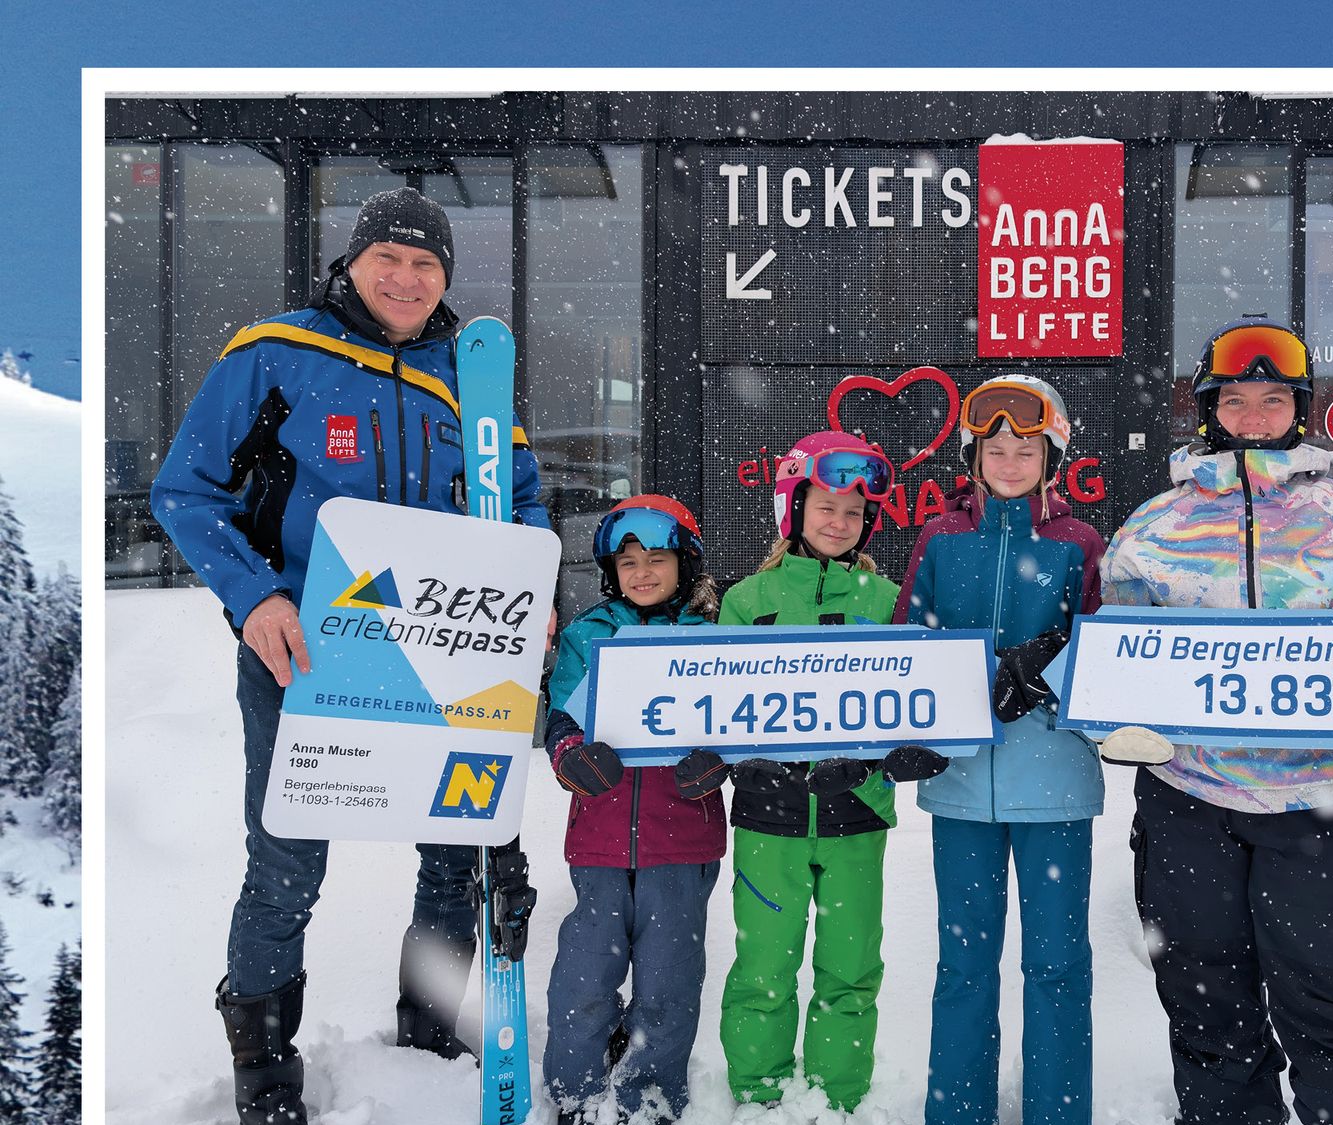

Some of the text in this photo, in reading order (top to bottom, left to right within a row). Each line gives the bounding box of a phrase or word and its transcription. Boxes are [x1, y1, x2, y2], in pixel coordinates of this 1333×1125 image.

[719, 165, 972, 228] TICKETS
[990, 256, 1112, 299] BERG
[990, 313, 1110, 340] LIFTE
[477, 416, 502, 522] EAD
[407, 577, 535, 633] BERG
[319, 612, 528, 657] erlebnispass
[1117, 630, 1162, 659] NÖ
[667, 653, 913, 677] Nachwuchsförderung
[314, 693, 511, 721] BERGERLEBNISPASS.AT
[641, 688, 936, 736] € 1.425.000
[289, 757, 318, 769] 1980
[291, 743, 371, 758] Anna Muster
[284, 779, 387, 794] Bergerlebnispass
[498, 1071, 514, 1081] PRO
[499, 1080, 515, 1125] RACE
